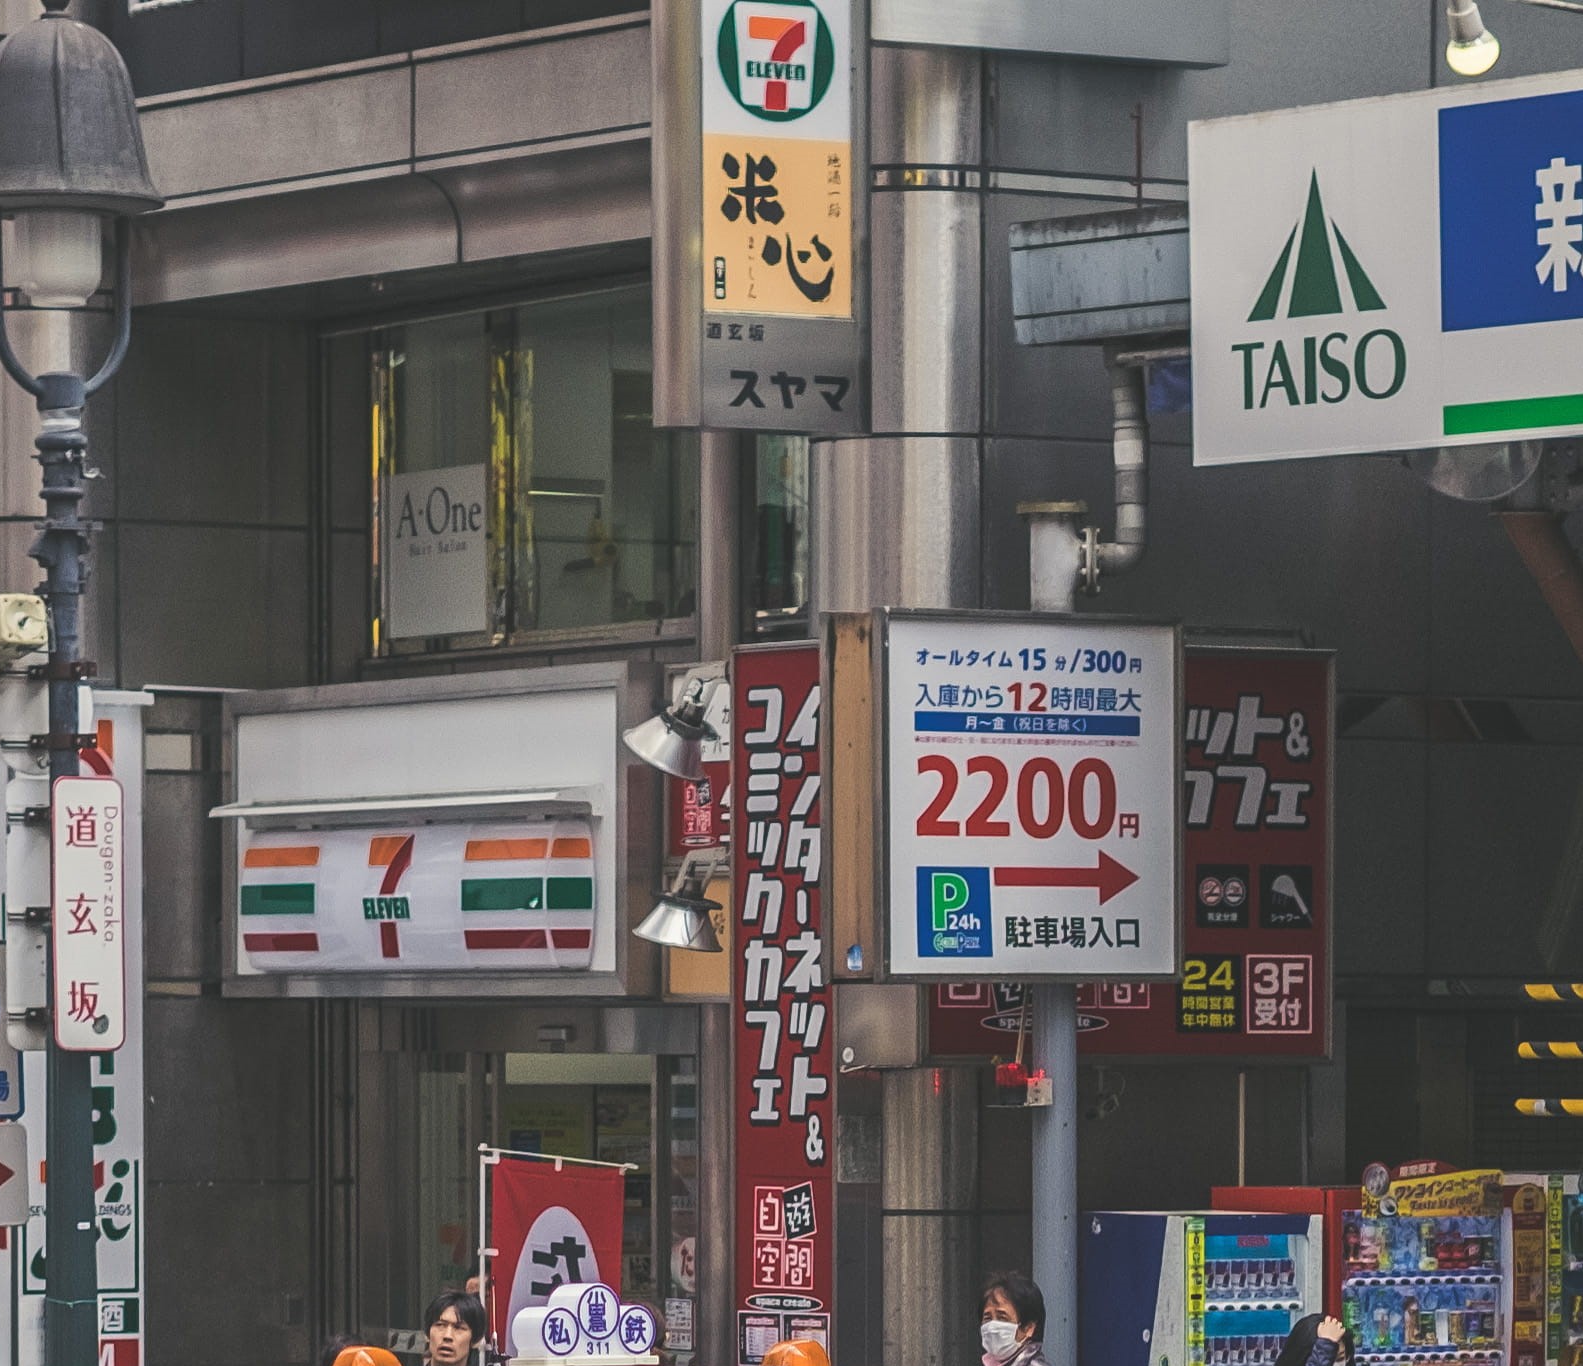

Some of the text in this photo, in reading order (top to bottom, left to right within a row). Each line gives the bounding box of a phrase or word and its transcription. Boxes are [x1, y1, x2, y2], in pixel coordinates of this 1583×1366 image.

[706, 322, 764, 342] 道玄坂
[1231, 328, 1408, 411] TAISO
[728, 369, 851, 412] スヤマ
[916, 649, 1014, 667] オールタイム
[914, 682, 1143, 713] 入庫から12時間最大
[915, 754, 1142, 840] 2200円
[99, 805, 120, 943] Dougen-zaka
[66, 805, 99, 1023] 道玄坂
[744, 686, 783, 1121] コミックカフェ
[784, 686, 827, 1117] インターネット
[931, 871, 970, 931] P
[948, 914, 982, 931] 24h
[1004, 915, 1142, 949] 駐車場入口
[1183, 960, 1235, 991] 24
[1253, 962, 1305, 996] 3F
[1182, 996, 1236, 1011] 時間営業
[1182, 1013, 1236, 1028] 年中無休
[1254, 998, 1301, 1027] 受付
[586, 1341, 612, 1356] 311
